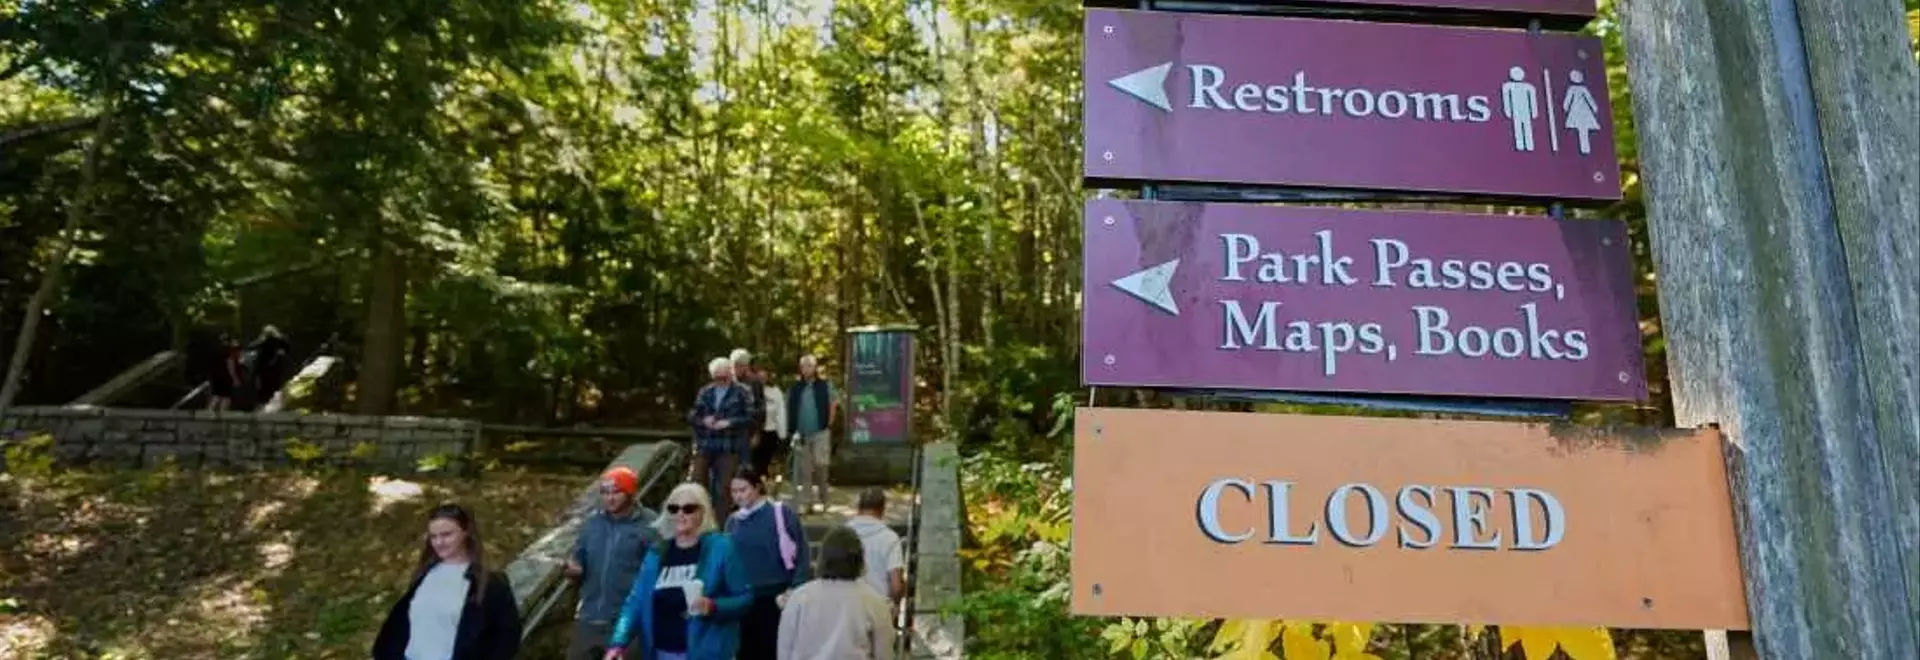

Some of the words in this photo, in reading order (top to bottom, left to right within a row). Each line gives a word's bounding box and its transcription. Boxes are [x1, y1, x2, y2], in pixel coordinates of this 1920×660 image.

[1186, 64, 1491, 123] Restrooms
[1218, 229, 1358, 287] Park
[1369, 238, 1565, 301] Passes,
[1217, 299, 1397, 376] Maps,
[1411, 303, 1589, 361] Books
[1195, 477, 1566, 552] CLOSED
